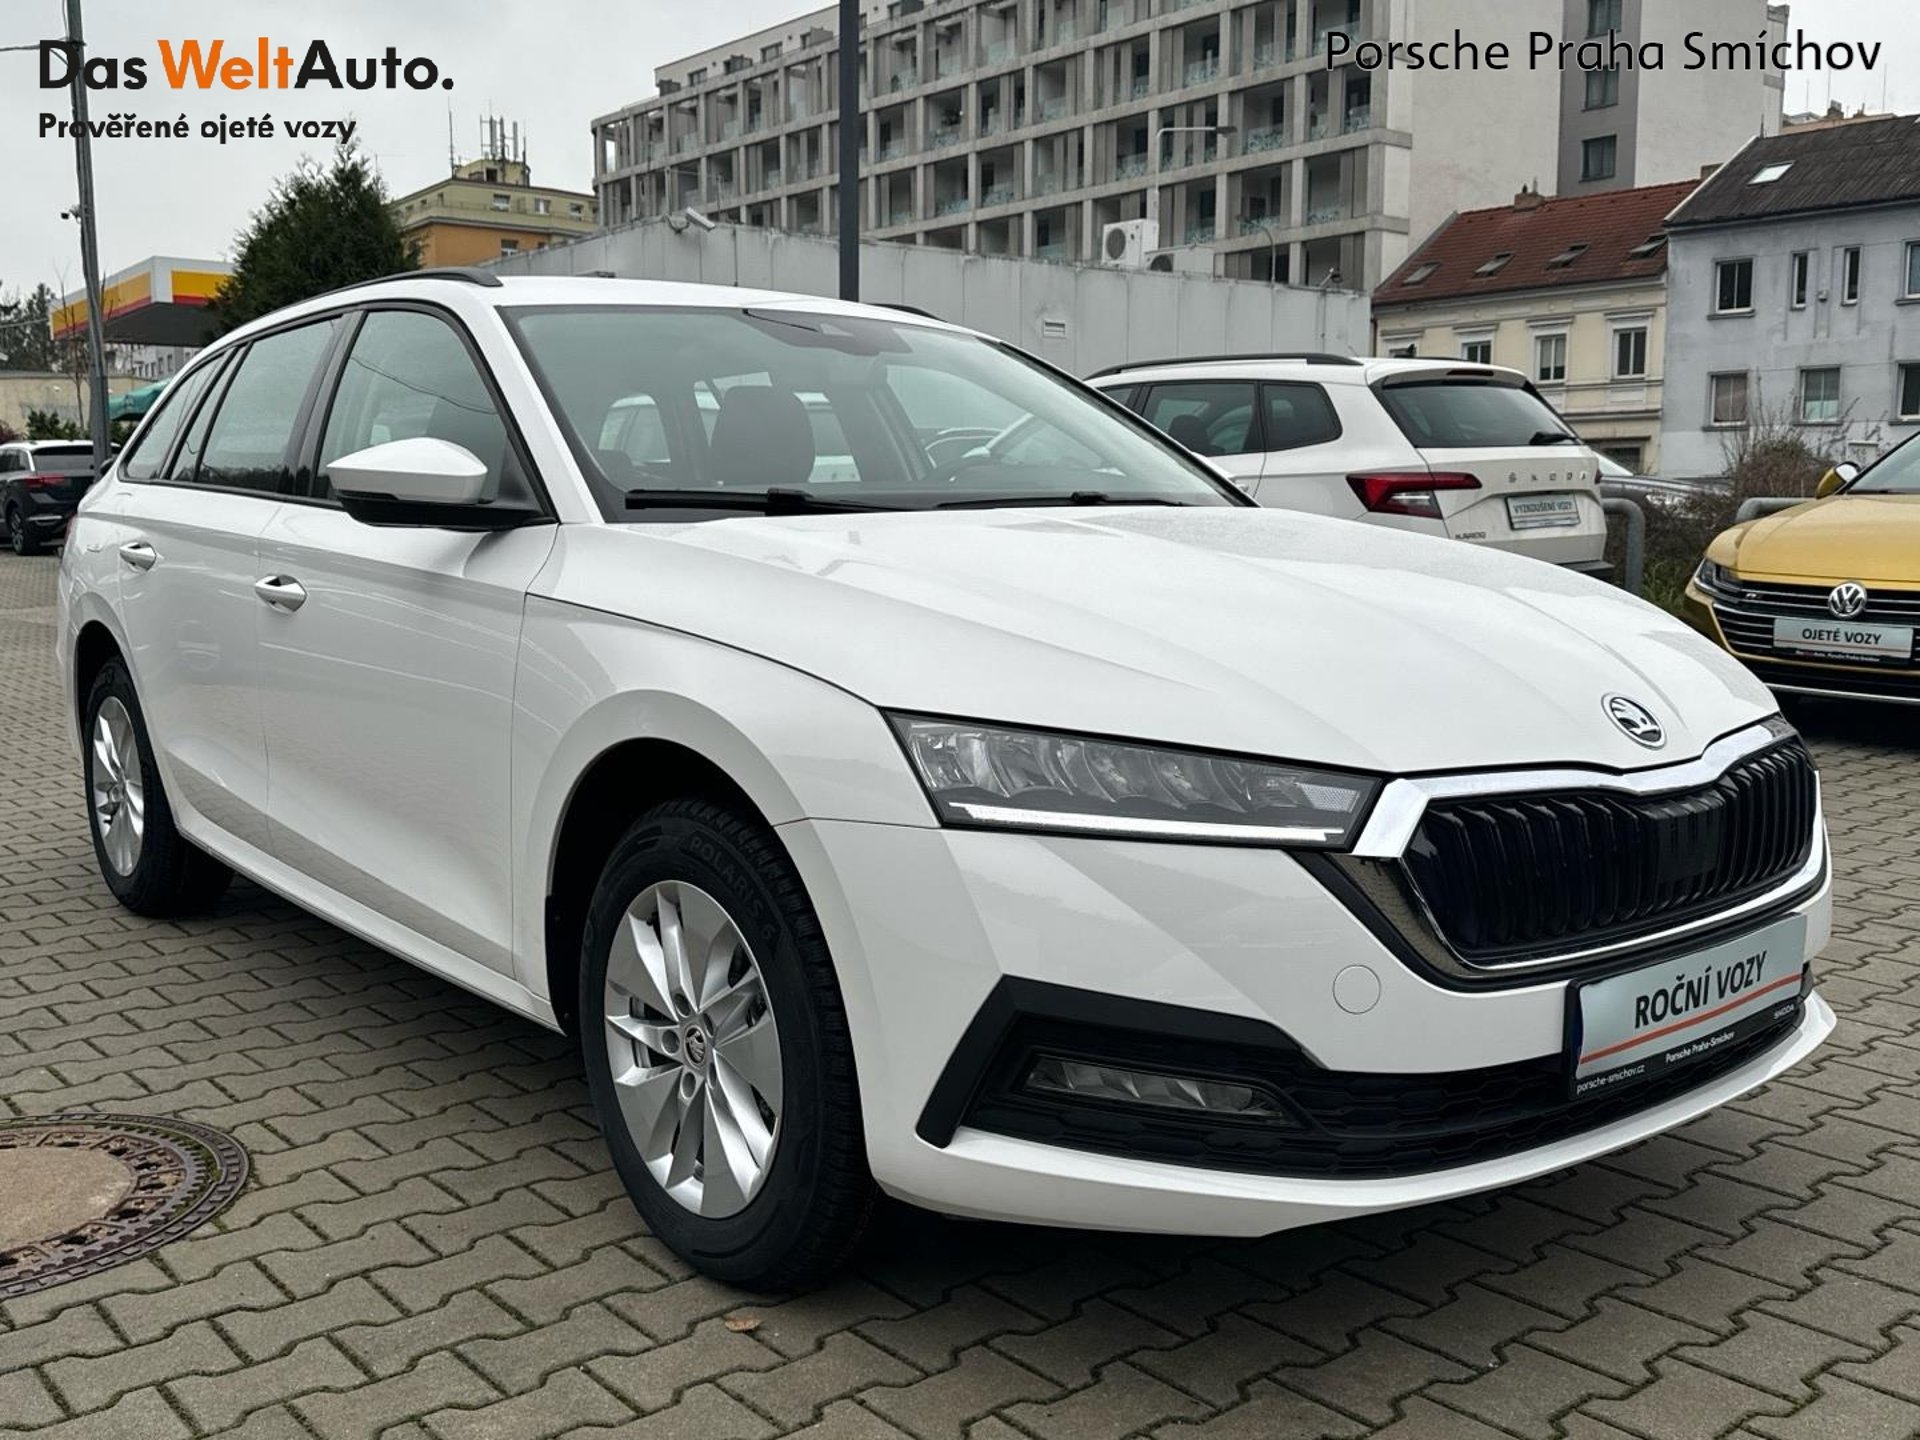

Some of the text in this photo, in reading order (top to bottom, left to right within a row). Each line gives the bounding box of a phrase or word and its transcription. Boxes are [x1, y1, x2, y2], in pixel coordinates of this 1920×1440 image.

[1801, 628, 1882, 645] OJETÉ VOZY
[688, 836, 765, 916] POLARIS
[1634, 951, 1768, 1029] ROČNÍ VOZY
[1665, 1047, 1692, 1064] Porsche
[1576, 1063, 1646, 1095] porsche-smichov.cz
